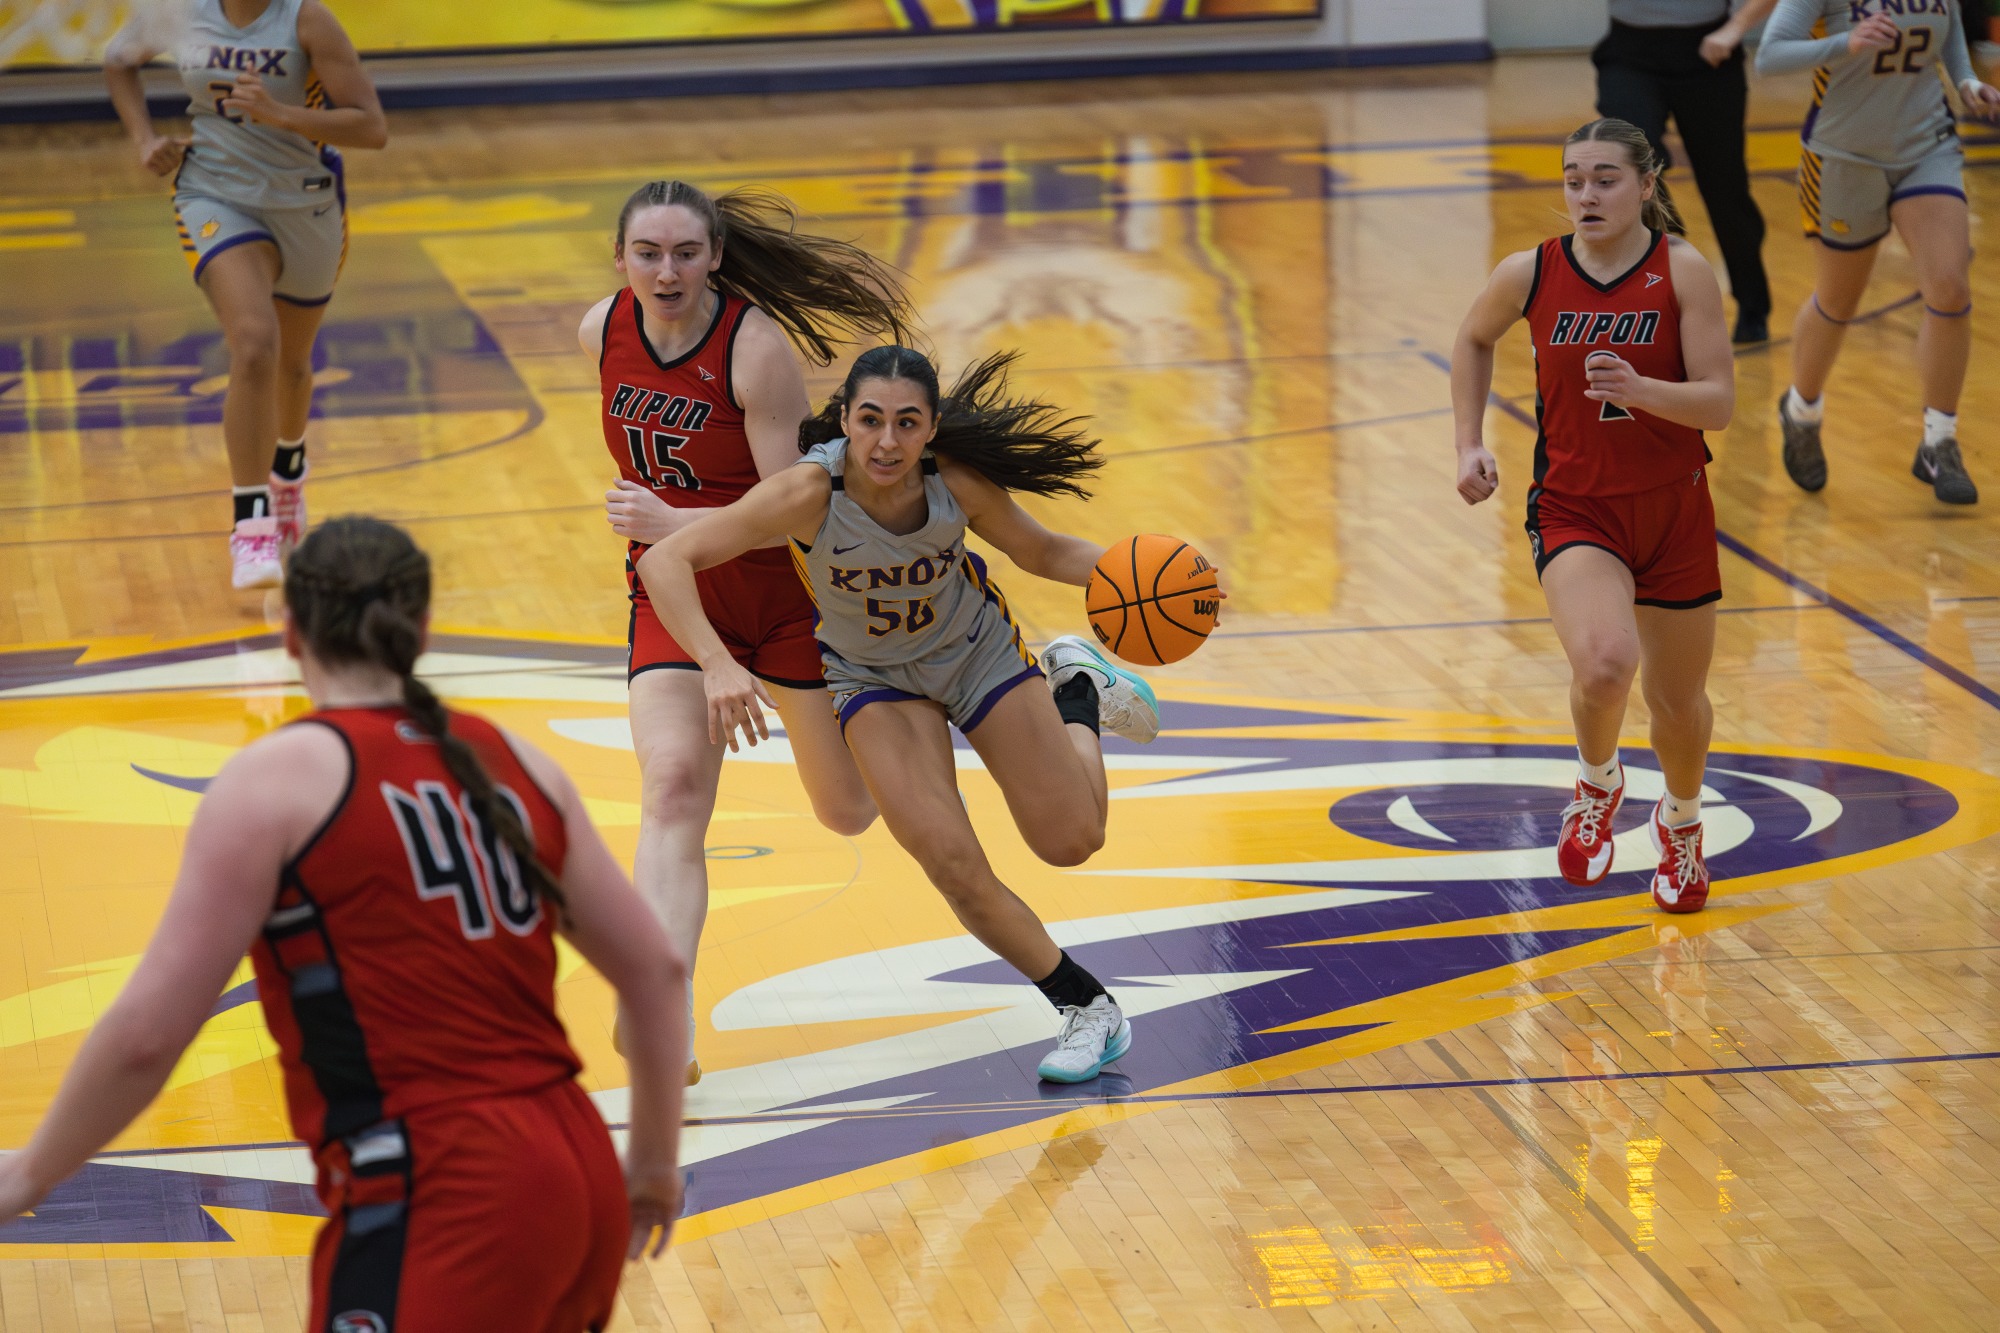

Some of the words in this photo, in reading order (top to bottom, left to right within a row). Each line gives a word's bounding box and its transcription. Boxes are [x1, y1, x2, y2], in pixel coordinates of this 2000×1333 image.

[1872, 26, 1932, 75] 22
[1549, 310, 1661, 345] RIPON
[609, 383, 713, 431] RIPON
[622, 424, 702, 490] 15
[379, 780, 546, 941] 40
